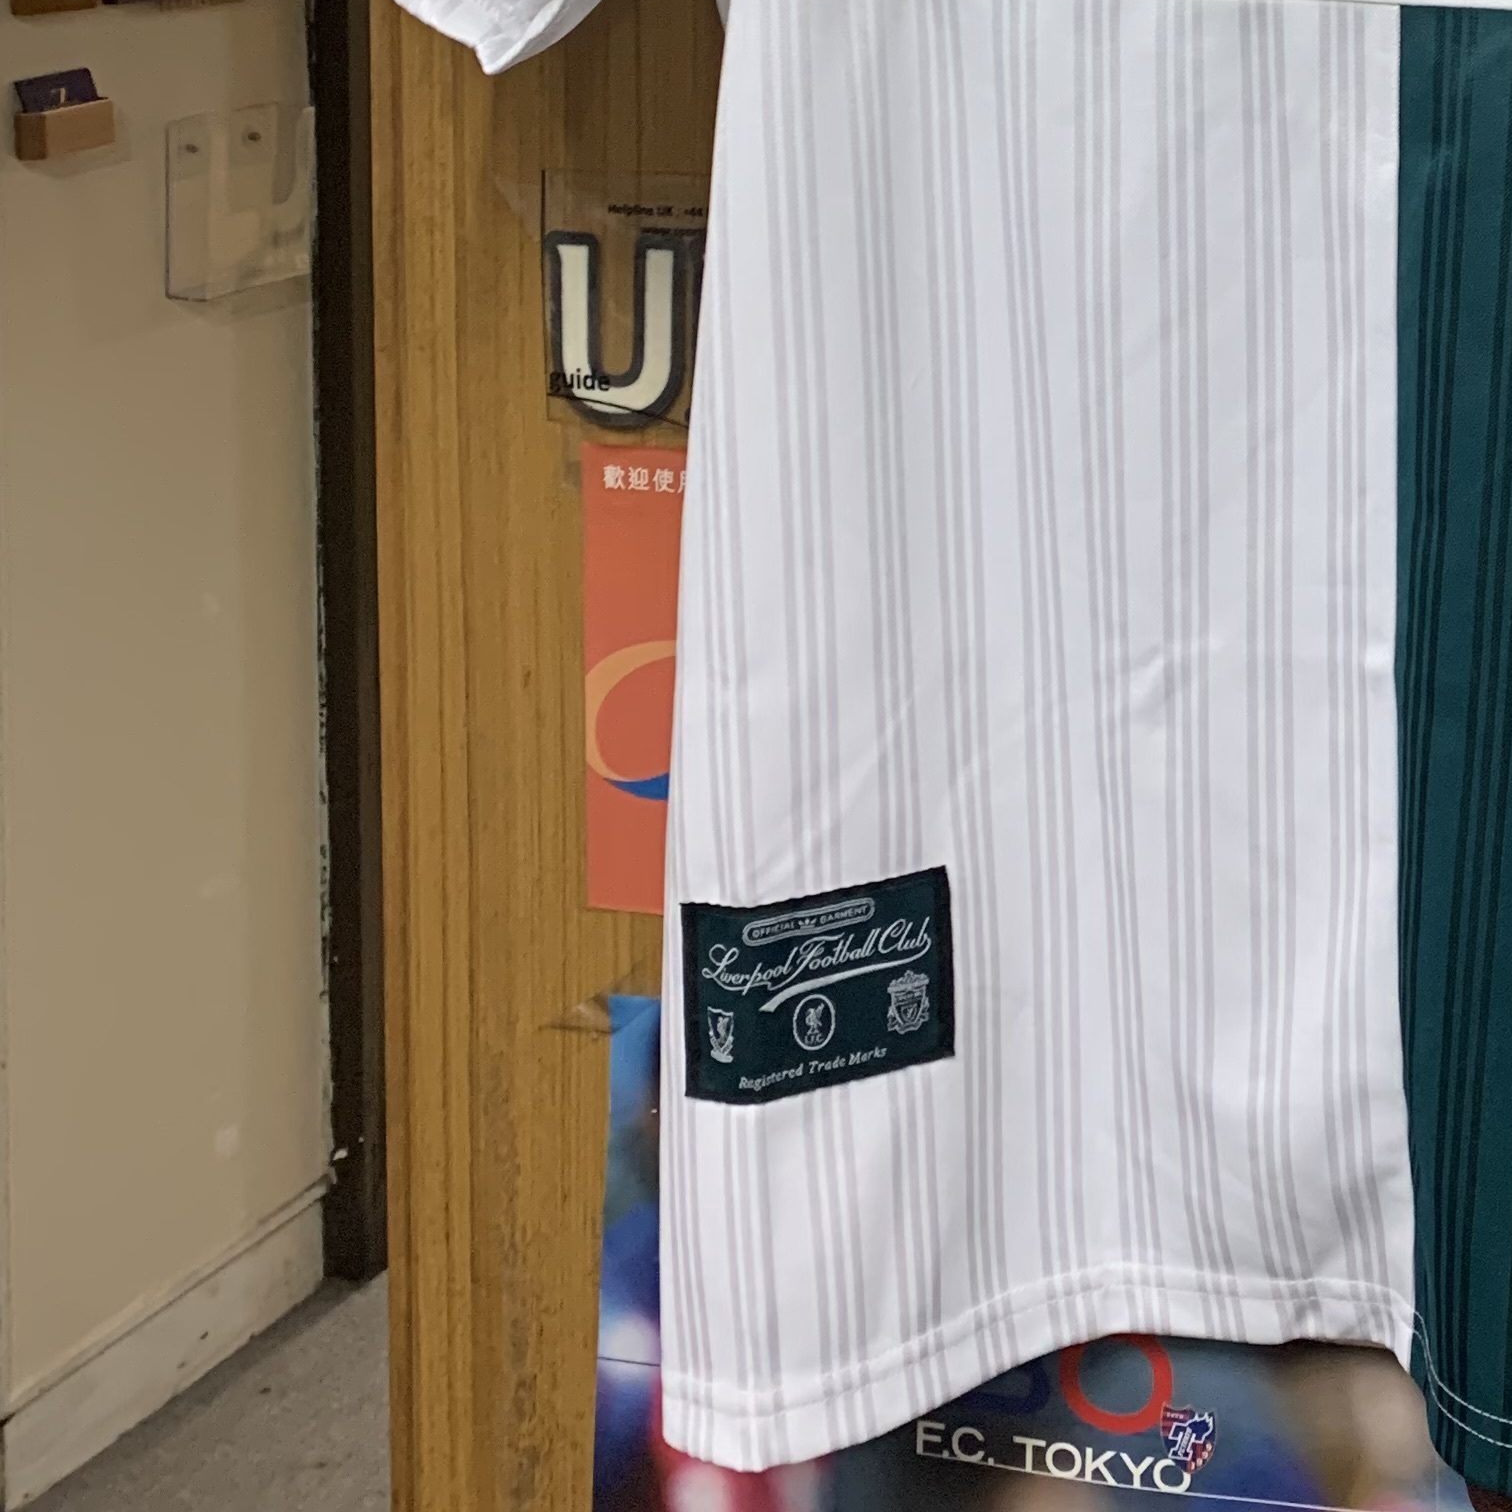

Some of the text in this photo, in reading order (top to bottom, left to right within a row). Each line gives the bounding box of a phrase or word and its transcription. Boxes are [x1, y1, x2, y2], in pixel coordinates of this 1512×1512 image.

[548, 367, 611, 392] guide
[702, 944, 798, 995] Liverpool
[878, 917, 931, 954] Club
[739, 1046, 888, 1092] Registered Trade Marks
[916, 1420, 995, 1466] F.C.
[1013, 1435, 1192, 1494] TOKYO
